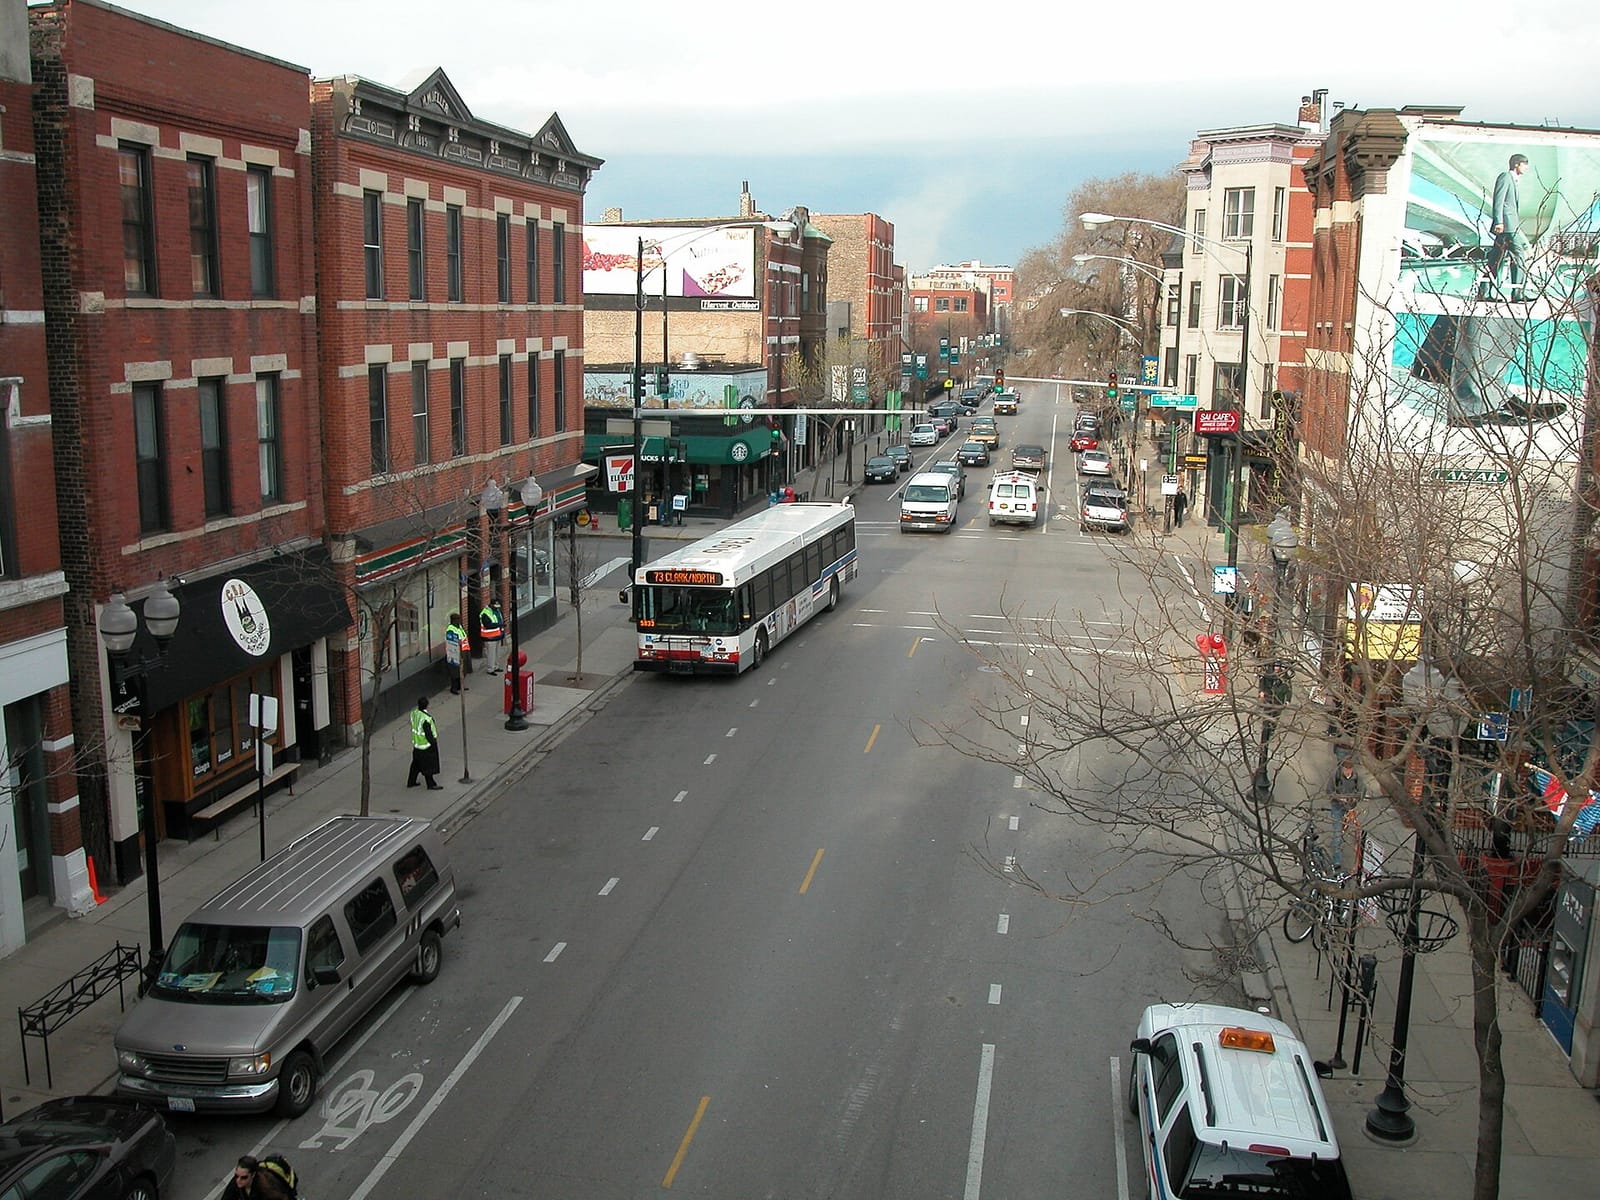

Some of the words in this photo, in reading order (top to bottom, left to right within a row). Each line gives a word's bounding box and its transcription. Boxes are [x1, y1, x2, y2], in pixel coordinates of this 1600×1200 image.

[725, 231, 749, 241] New!
[1434, 471, 1501, 482] LAMAR
[654, 571, 664, 583] 73
[665, 572, 716, 584] CLARK/NORTH
